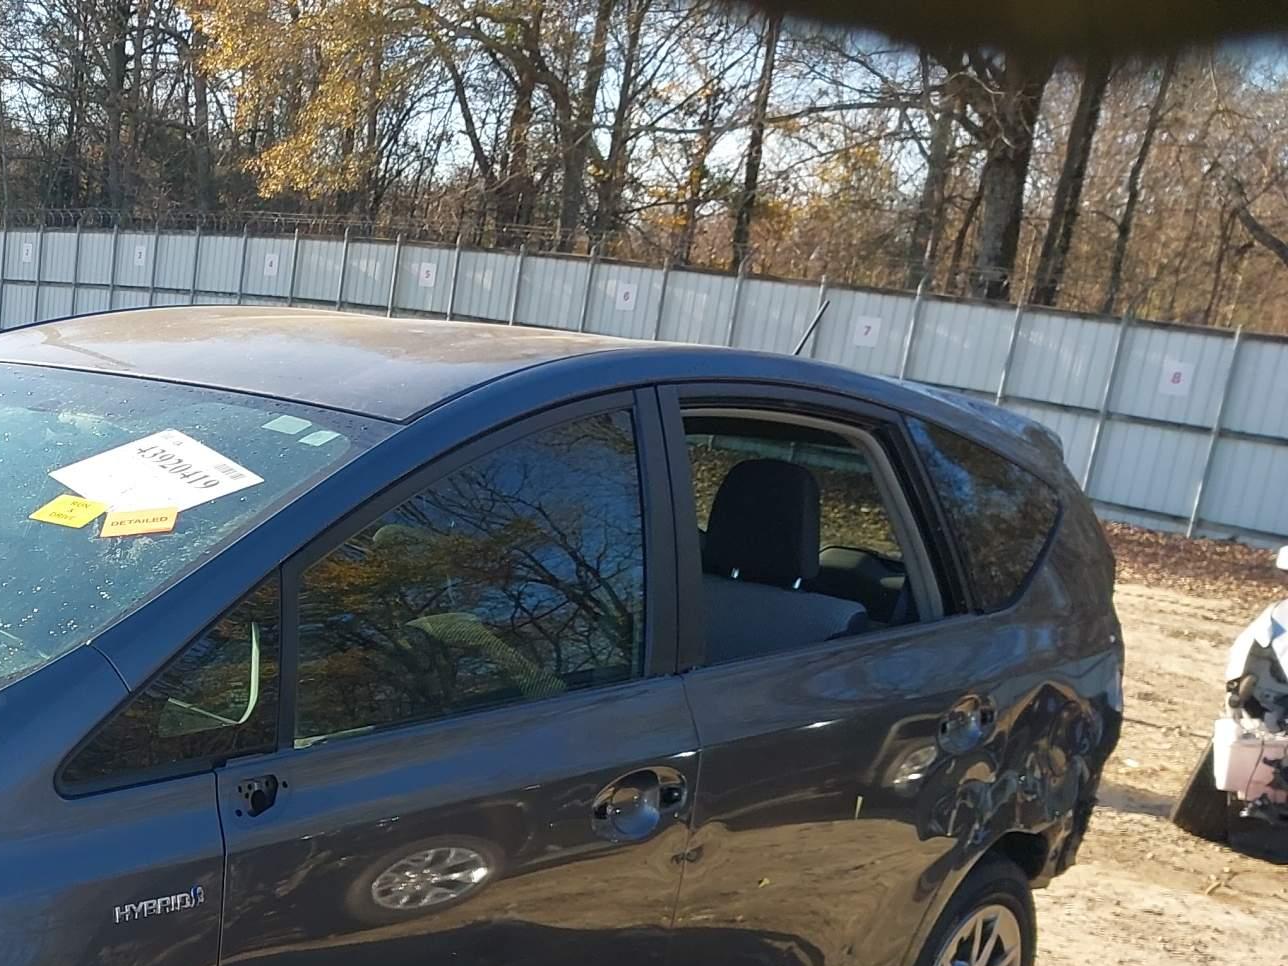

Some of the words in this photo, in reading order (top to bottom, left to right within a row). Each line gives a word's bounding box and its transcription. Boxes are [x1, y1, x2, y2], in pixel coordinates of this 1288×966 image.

[269, 260, 275, 268] 4
[424, 269, 431, 280] 5
[623, 291, 630, 302] 6
[863, 324, 872, 337] 7
[1170, 371, 1182, 385] 8
[136, 445, 220, 489] 43920419
[110, 516, 169, 527] DETAILED
[114, 892, 194, 923] HYBRID
